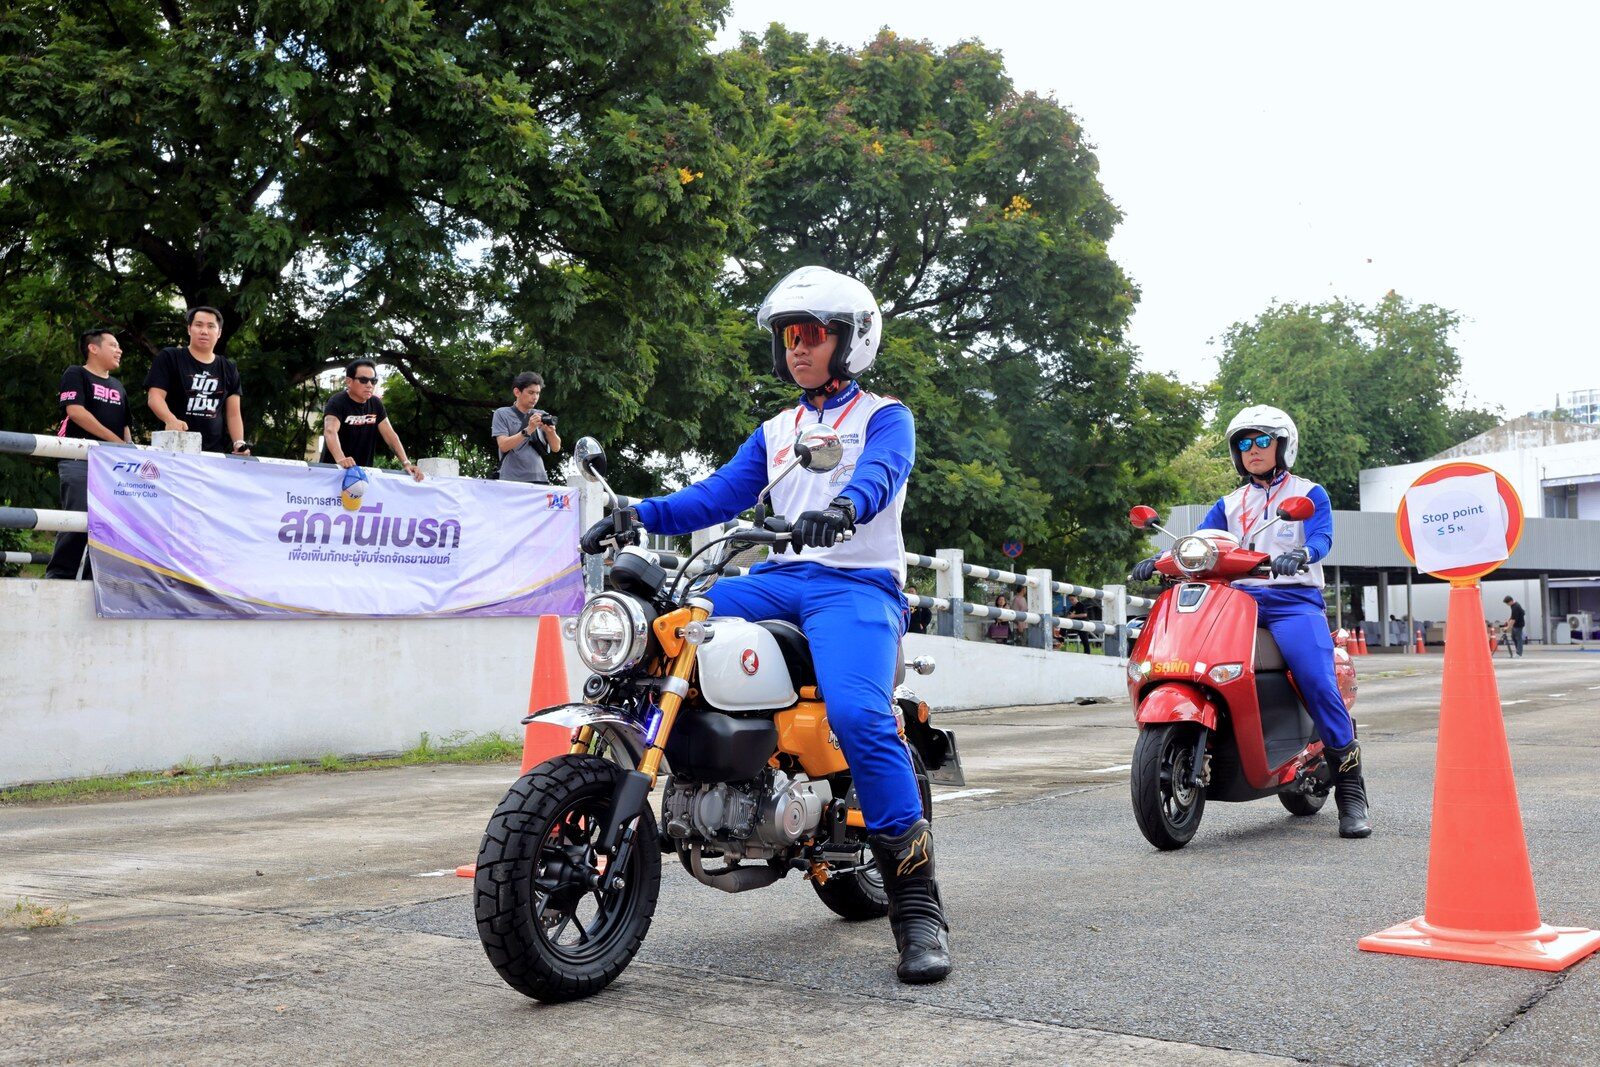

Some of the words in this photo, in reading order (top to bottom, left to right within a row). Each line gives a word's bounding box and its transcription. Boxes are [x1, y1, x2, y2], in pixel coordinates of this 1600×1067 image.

[92, 383, 120, 401] BIG
[113, 462, 141, 473] FTI
[117, 481, 156, 490] Automotive
[113, 489, 141, 498] Industry
[286, 491, 343, 507] โครงการสาธิ
[1422, 512, 1449, 524] Stop
[1453, 504, 1484, 520] point
[277, 502, 462, 549] สถานีเบรก
[1448, 524, 1456, 534] 5
